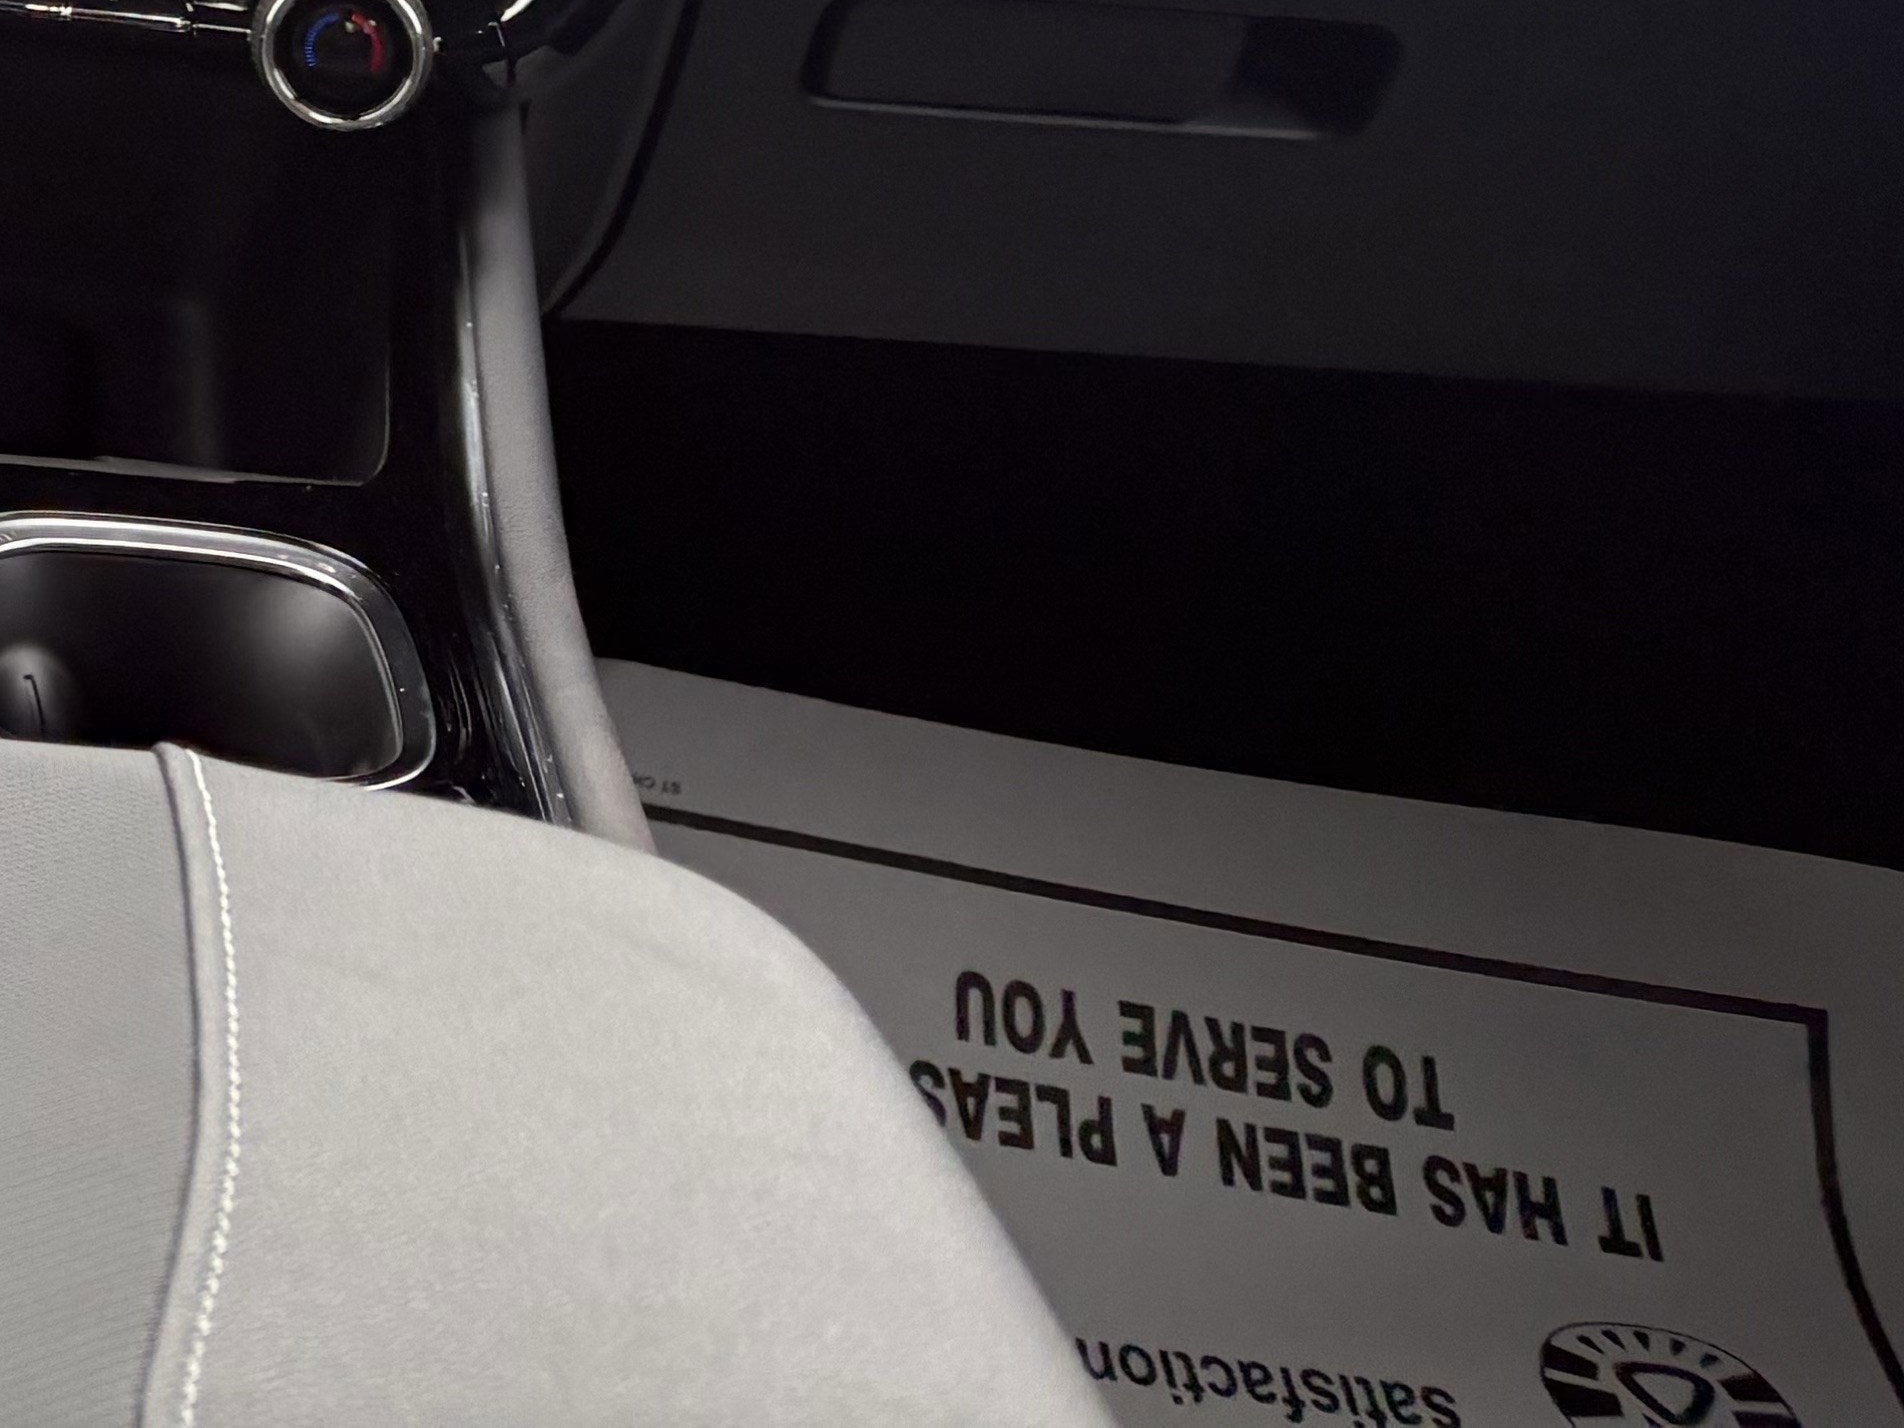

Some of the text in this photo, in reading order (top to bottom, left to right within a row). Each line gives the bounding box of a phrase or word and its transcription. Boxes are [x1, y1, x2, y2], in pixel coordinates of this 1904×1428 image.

[956, 971, 1454, 1130] TO SERVE YOU
[1143, 1104, 1185, 1176] A
[1217, 1119, 1396, 1215] BEEN
[1423, 1156, 1567, 1245] HAS
[1599, 1188, 1663, 1261] IT
[1076, 1338, 1461, 1428] satisfaction
